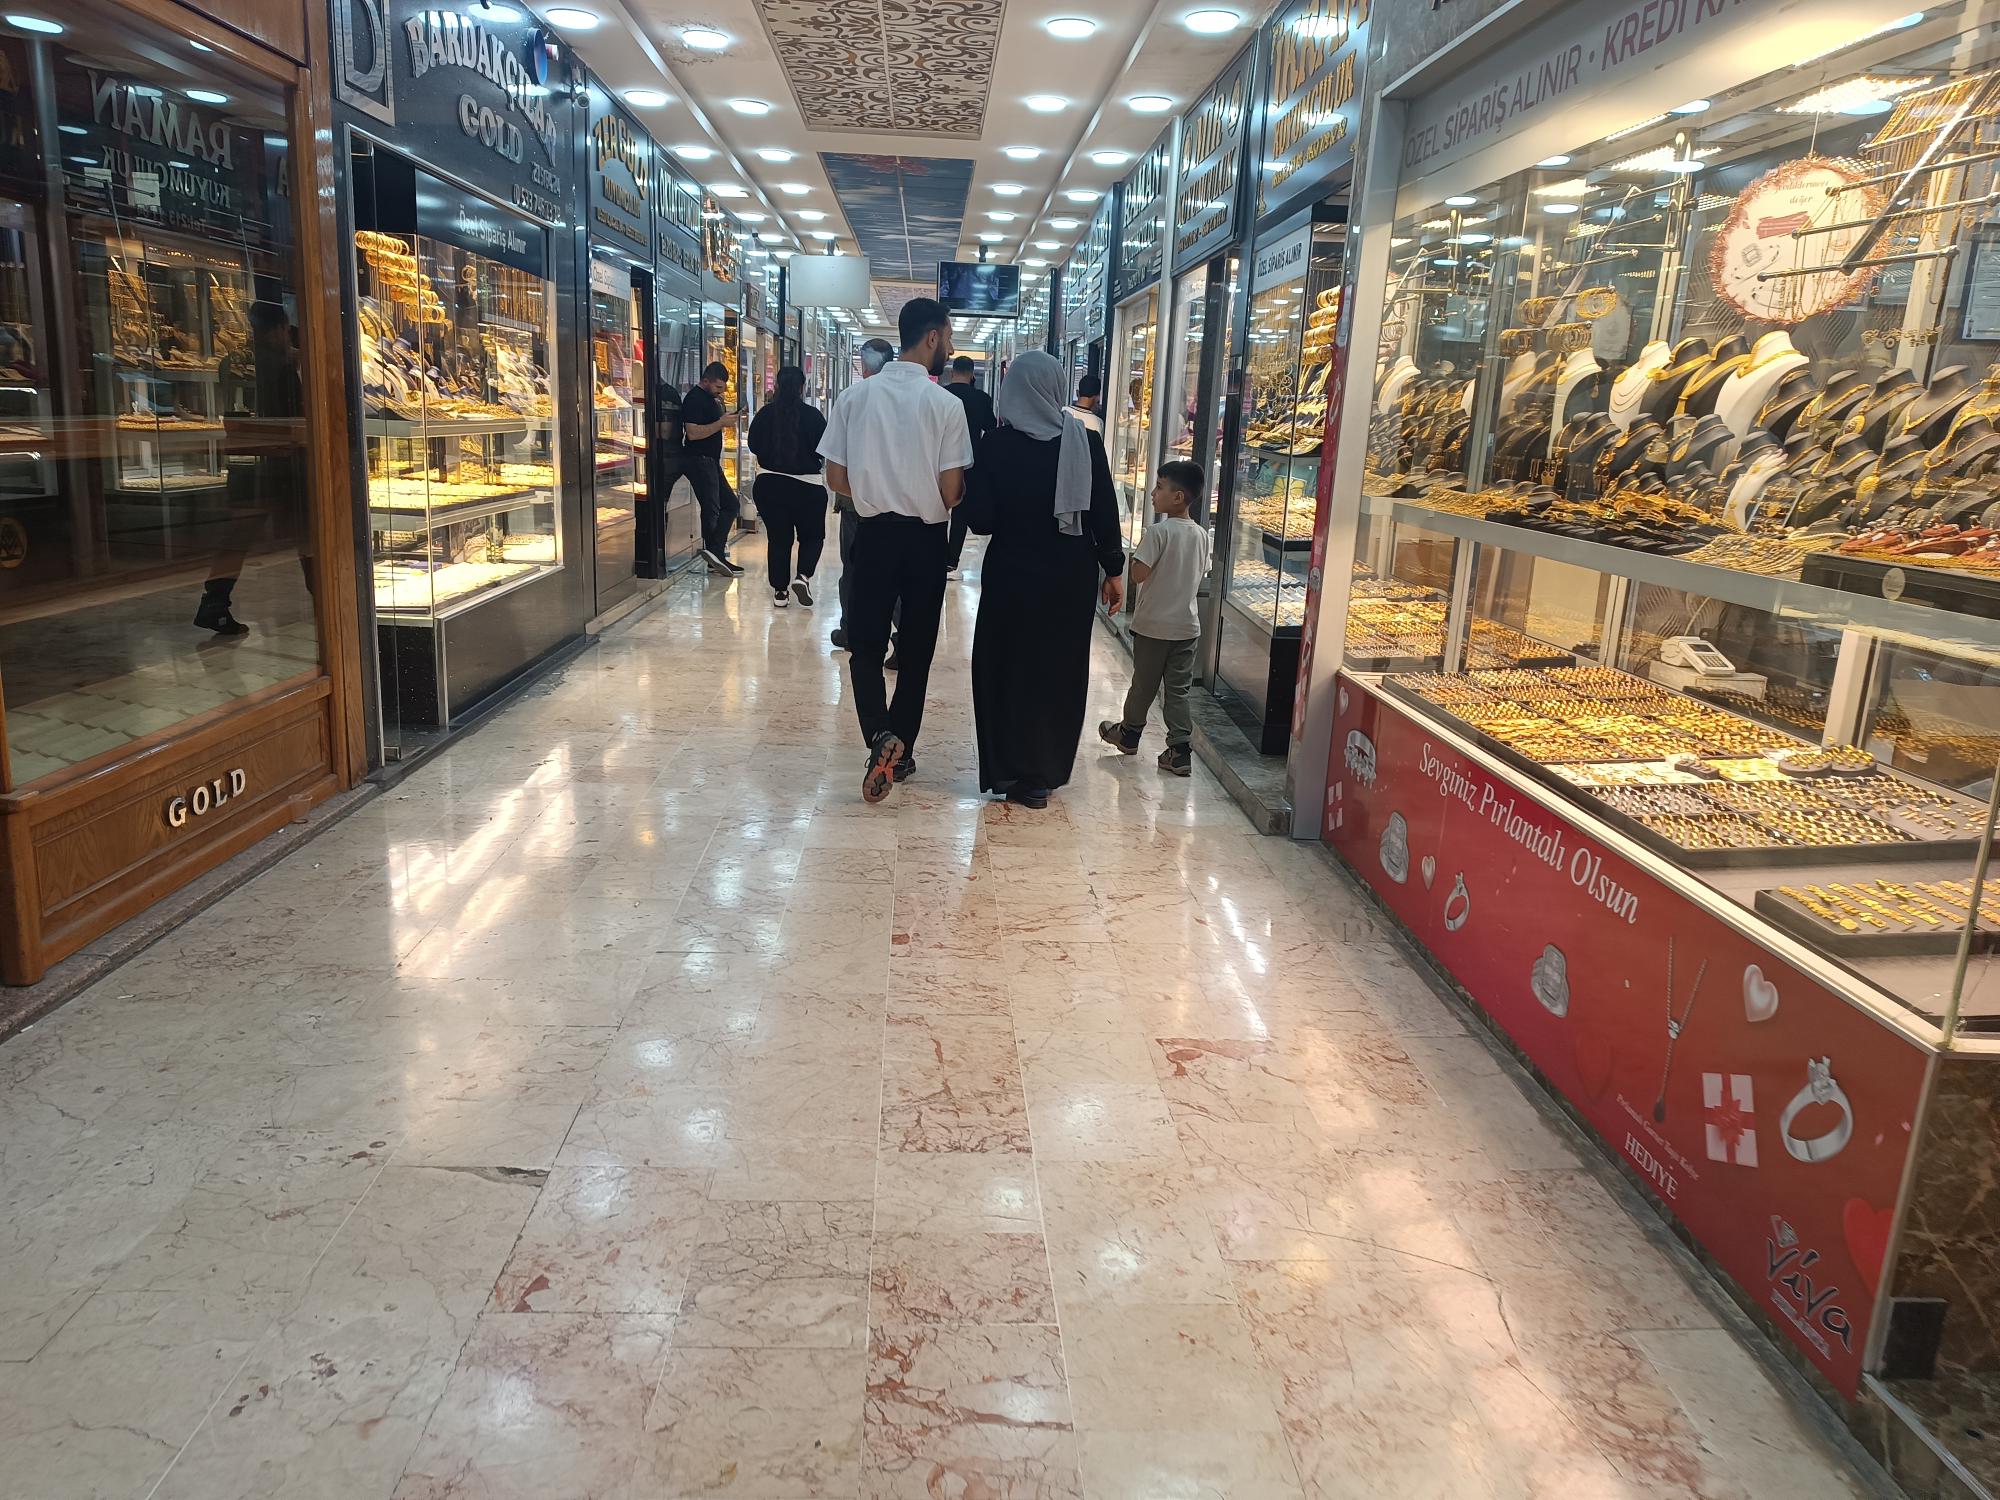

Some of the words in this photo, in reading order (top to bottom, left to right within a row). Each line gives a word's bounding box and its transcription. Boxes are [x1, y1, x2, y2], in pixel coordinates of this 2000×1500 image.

[459, 94, 523, 165] GOLD
[1405, 123, 1440, 169] ÖZEL
[1443, 80, 1509, 151] SİPARİŞ
[1509, 44, 1582, 118] ALINIR
[167, 767, 247, 828] GOLD
[1419, 742, 1476, 812] Sevginiz
[1478, 782, 1566, 871] Pırlantalı
[1570, 847, 1639, 925] Olsun
